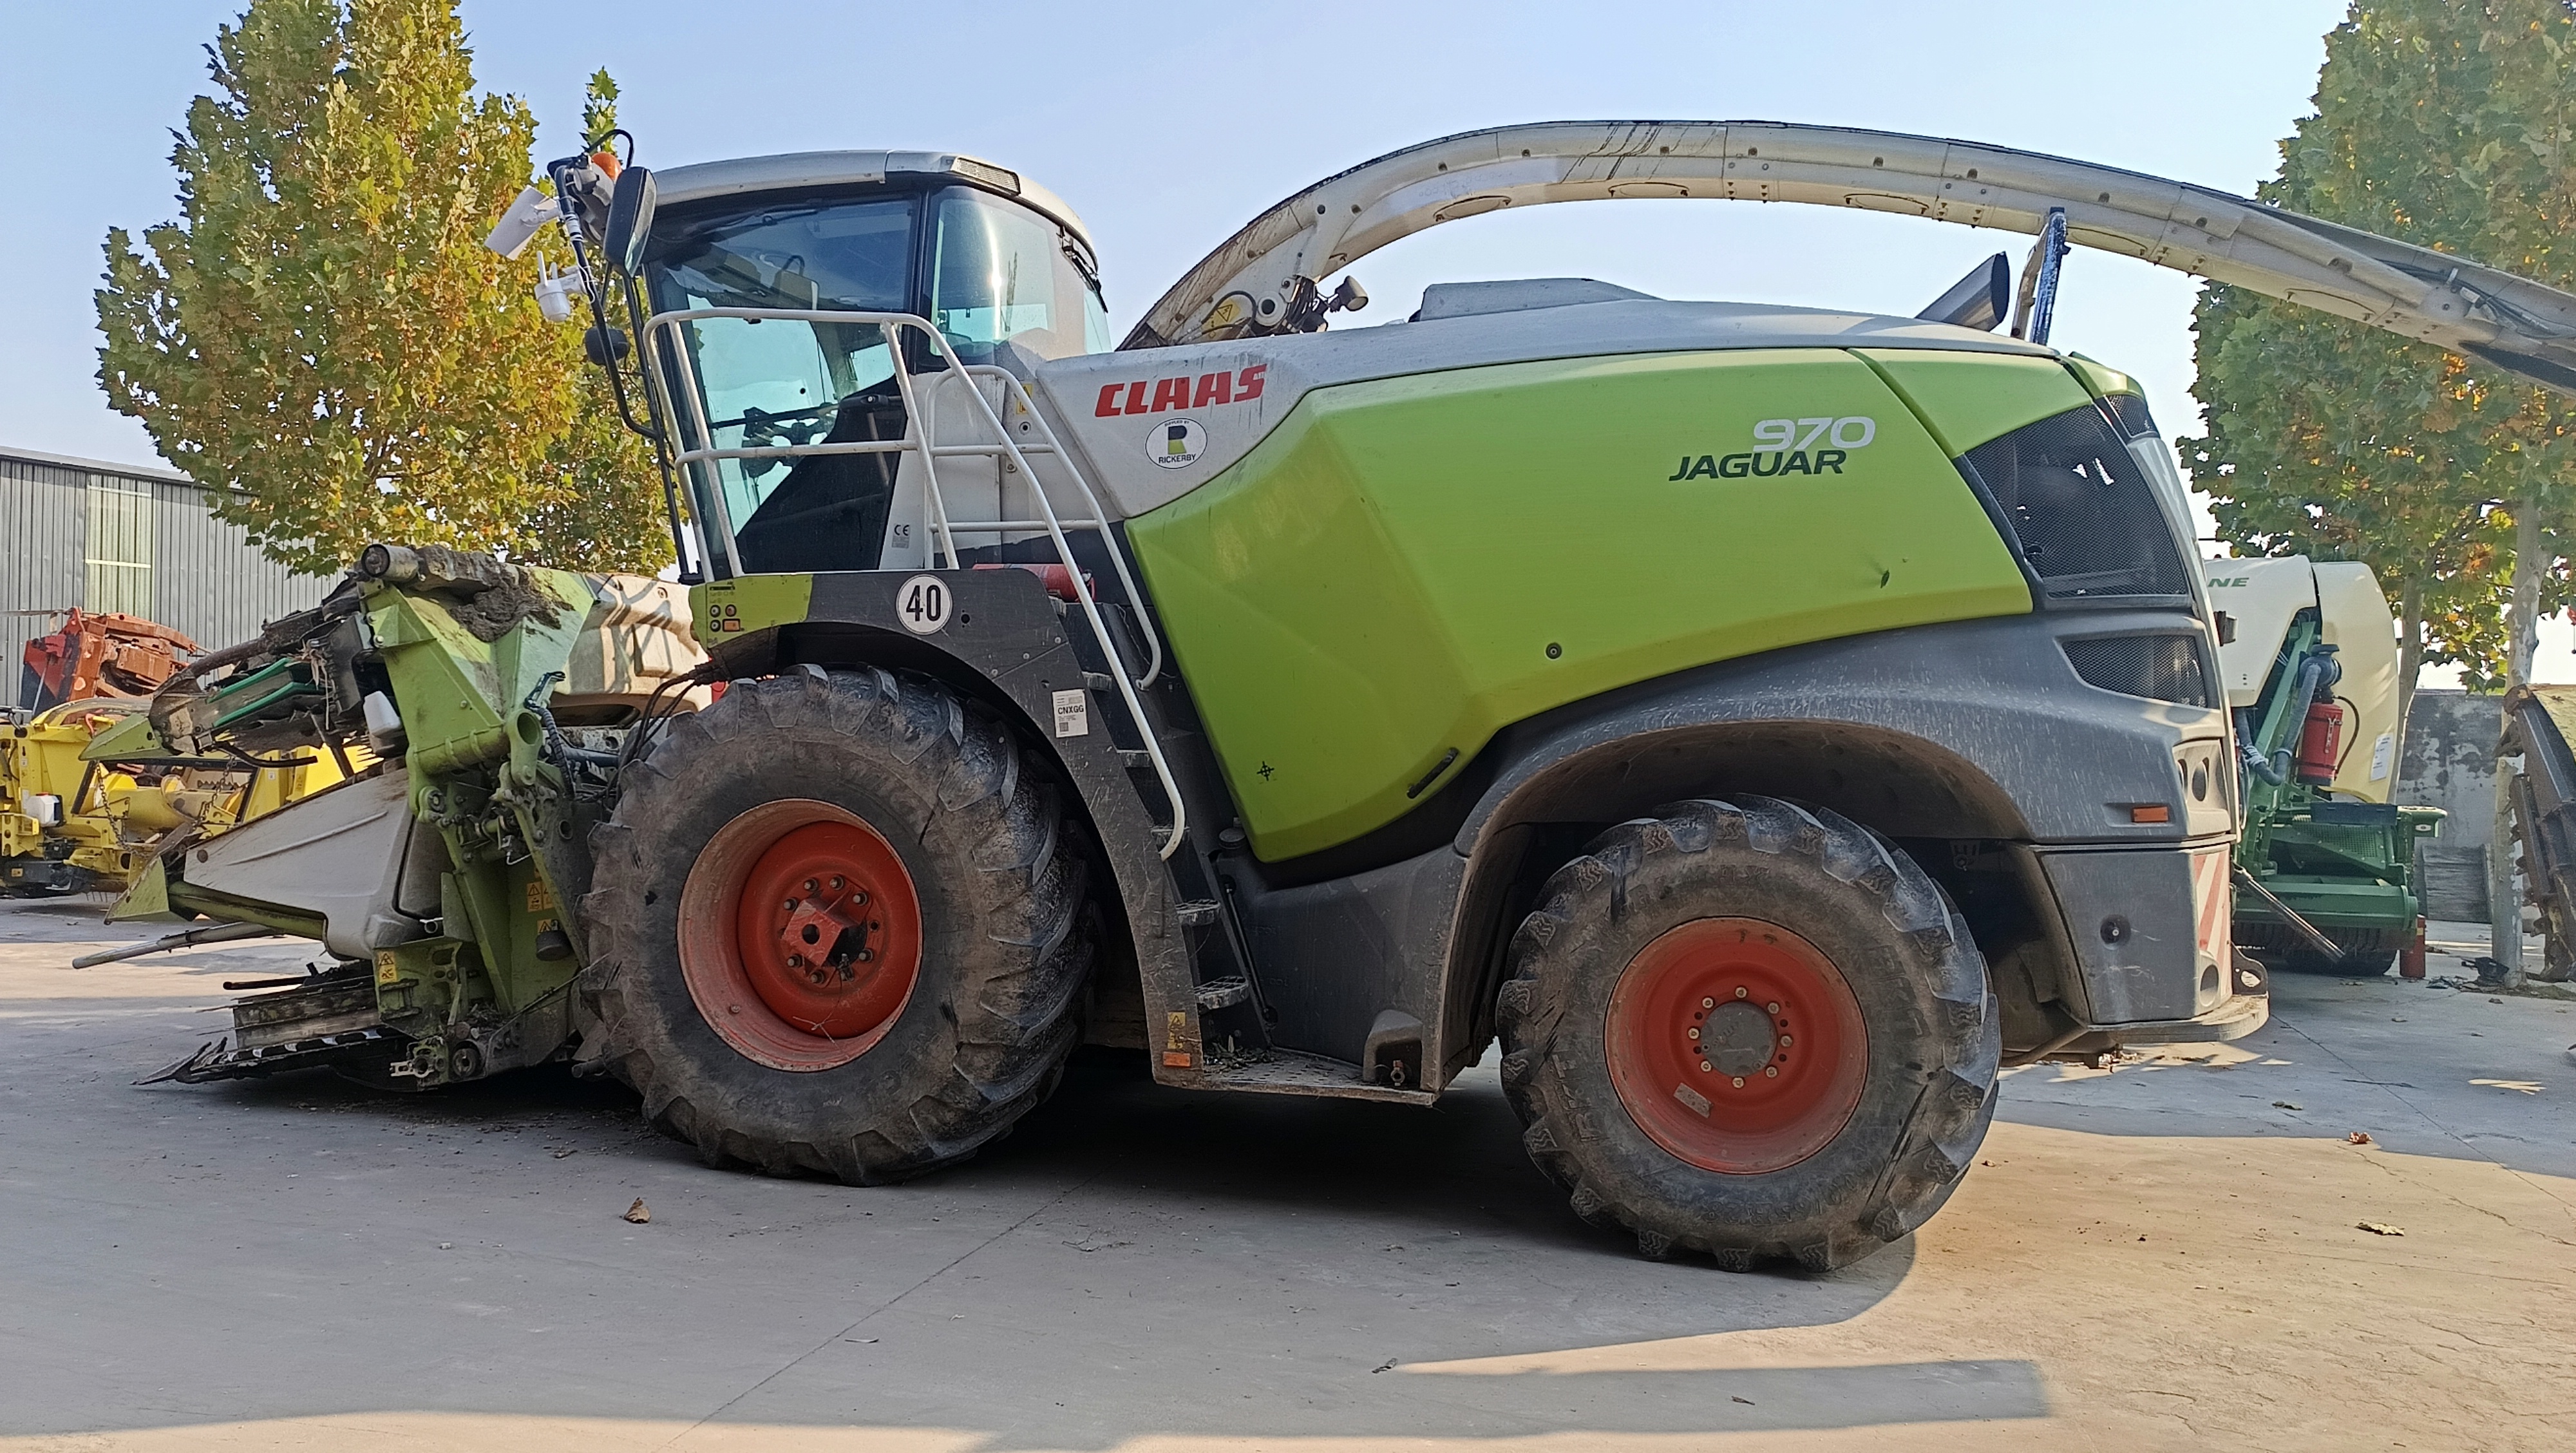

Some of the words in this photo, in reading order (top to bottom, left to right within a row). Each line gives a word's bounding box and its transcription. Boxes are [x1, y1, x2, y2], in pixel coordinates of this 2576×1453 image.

[1095, 363, 1267, 417] CLAAS
[1752, 416, 1876, 452] 970
[1158, 453, 1197, 464] RICKERBY
[1669, 450, 1846, 481] JAGUAR
[905, 584, 941, 622] 40
[1057, 705, 1084, 714] CNXGG
